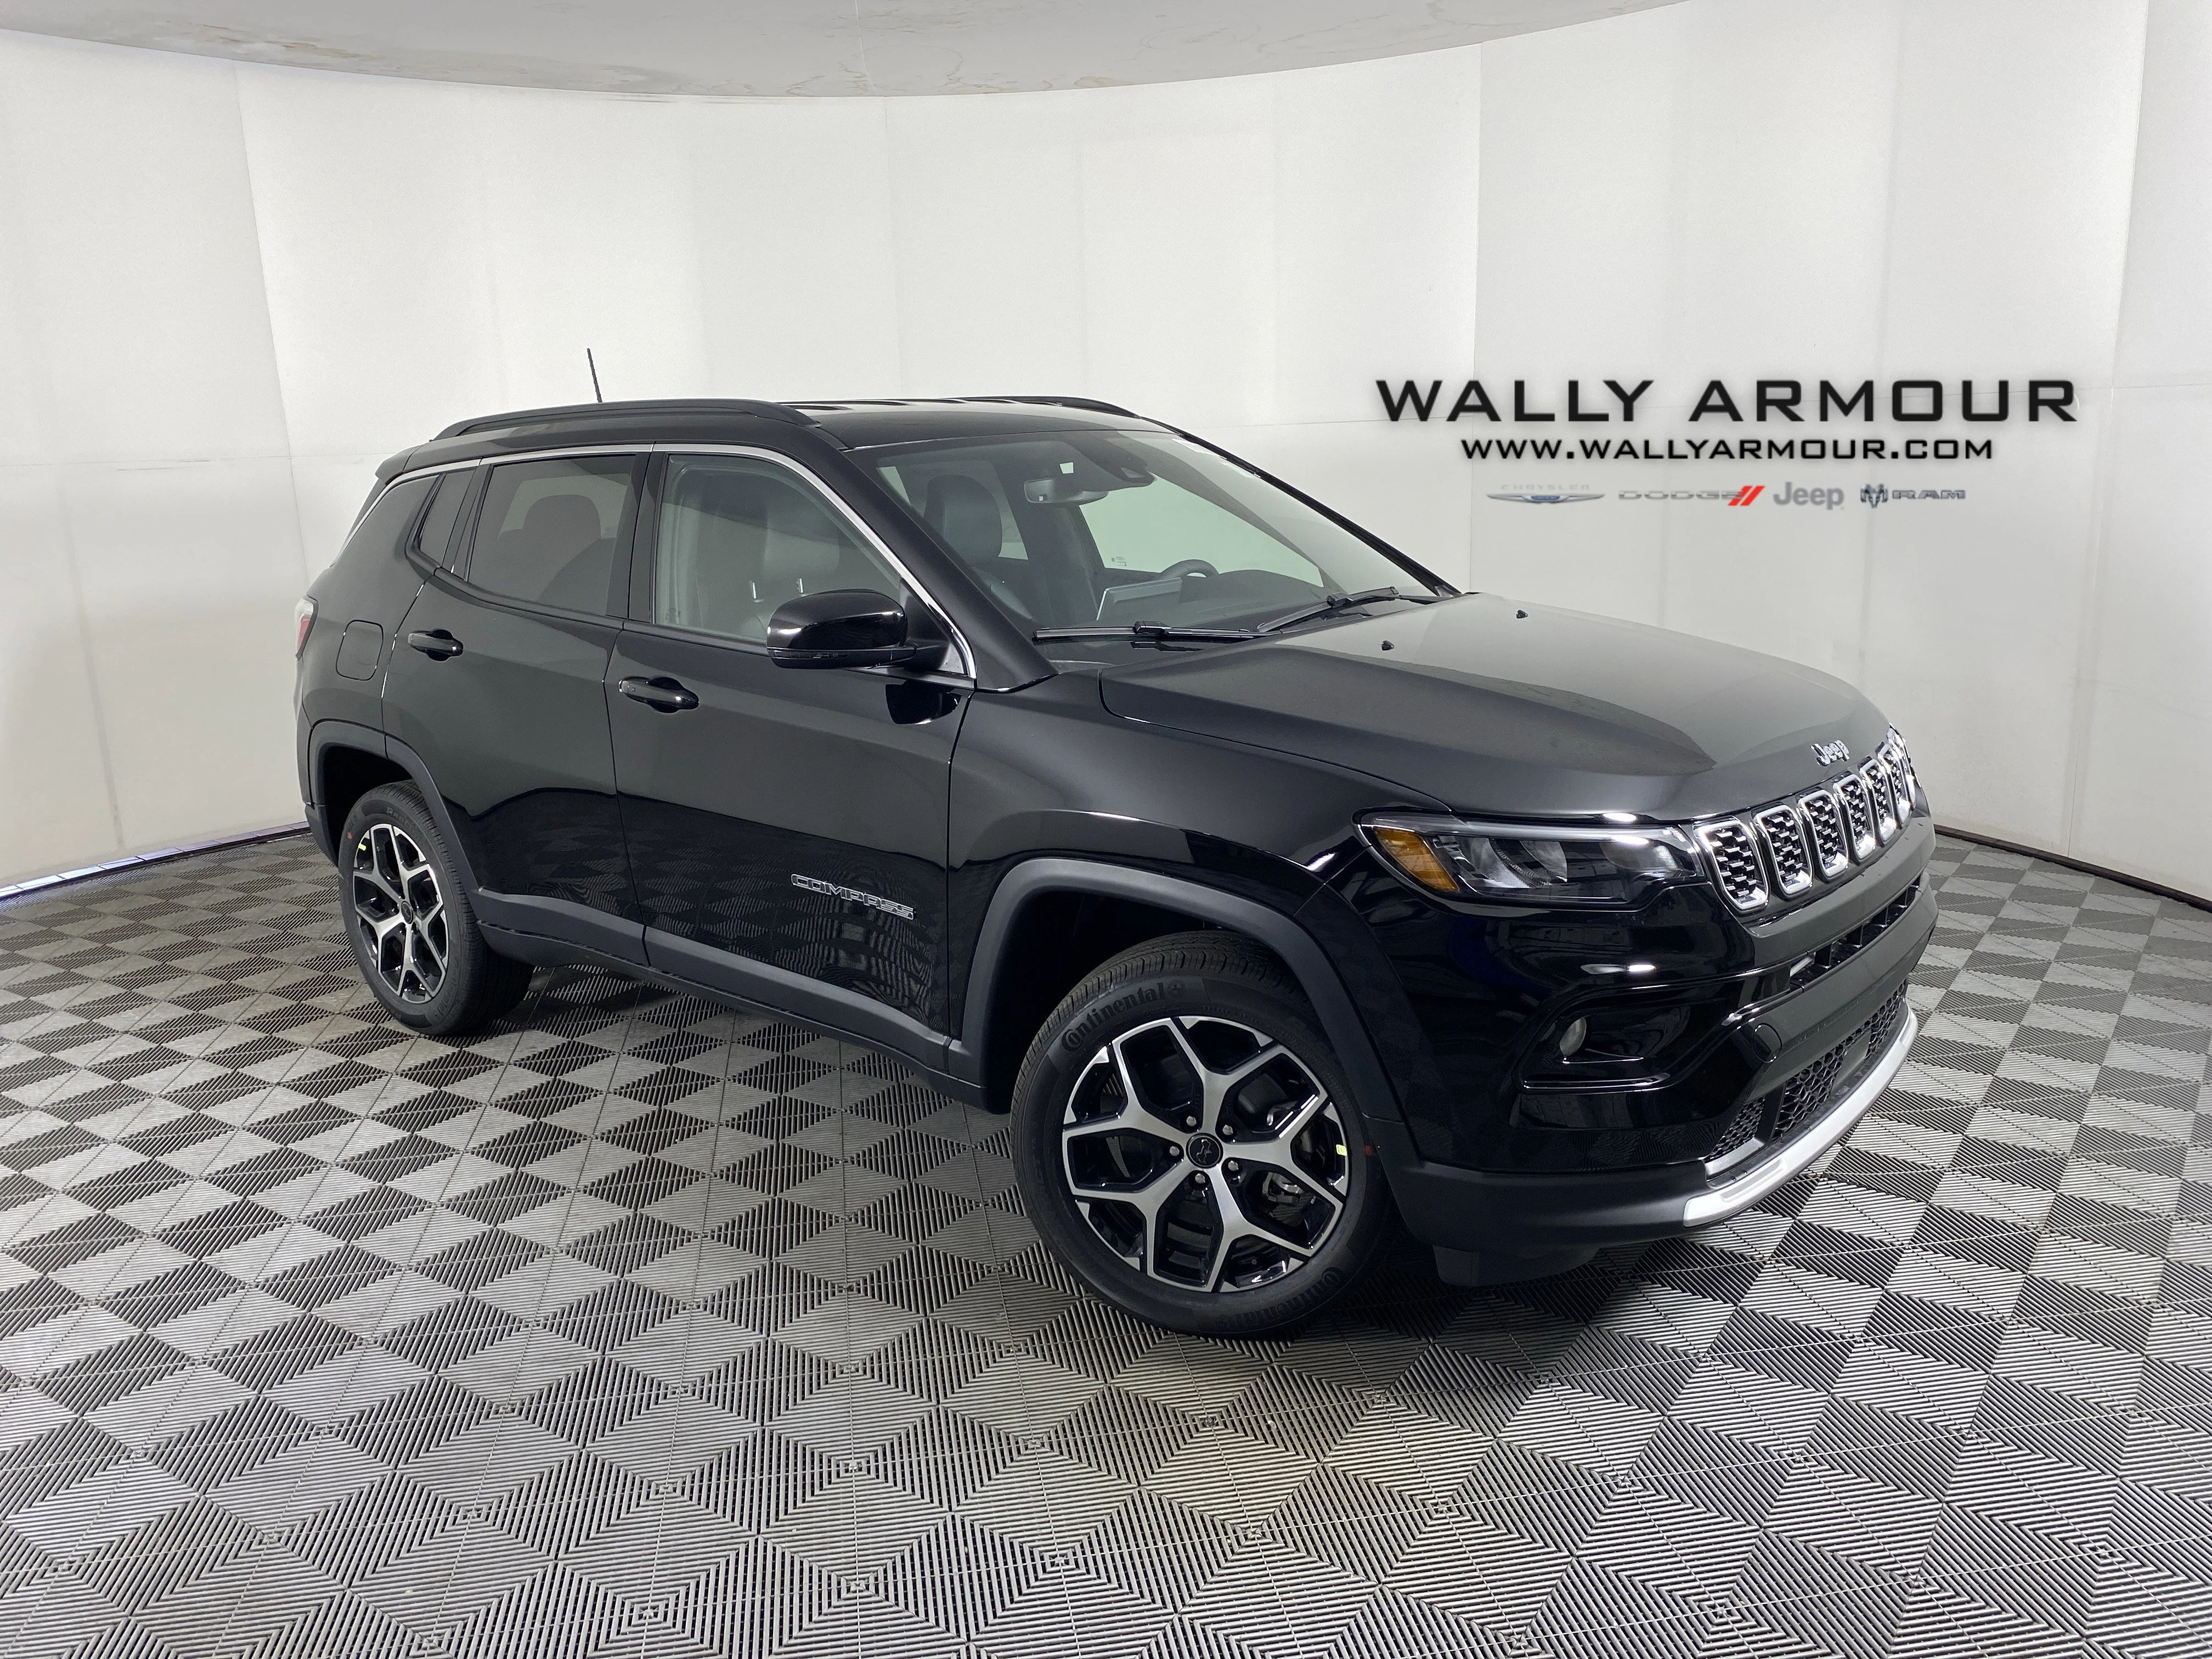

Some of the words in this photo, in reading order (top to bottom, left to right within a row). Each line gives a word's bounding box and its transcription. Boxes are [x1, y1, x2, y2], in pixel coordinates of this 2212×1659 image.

[1810, 740, 1850, 766] Jeep
[791, 873, 915, 921] COMPASS
[1060, 981, 1166, 1053] Continental
